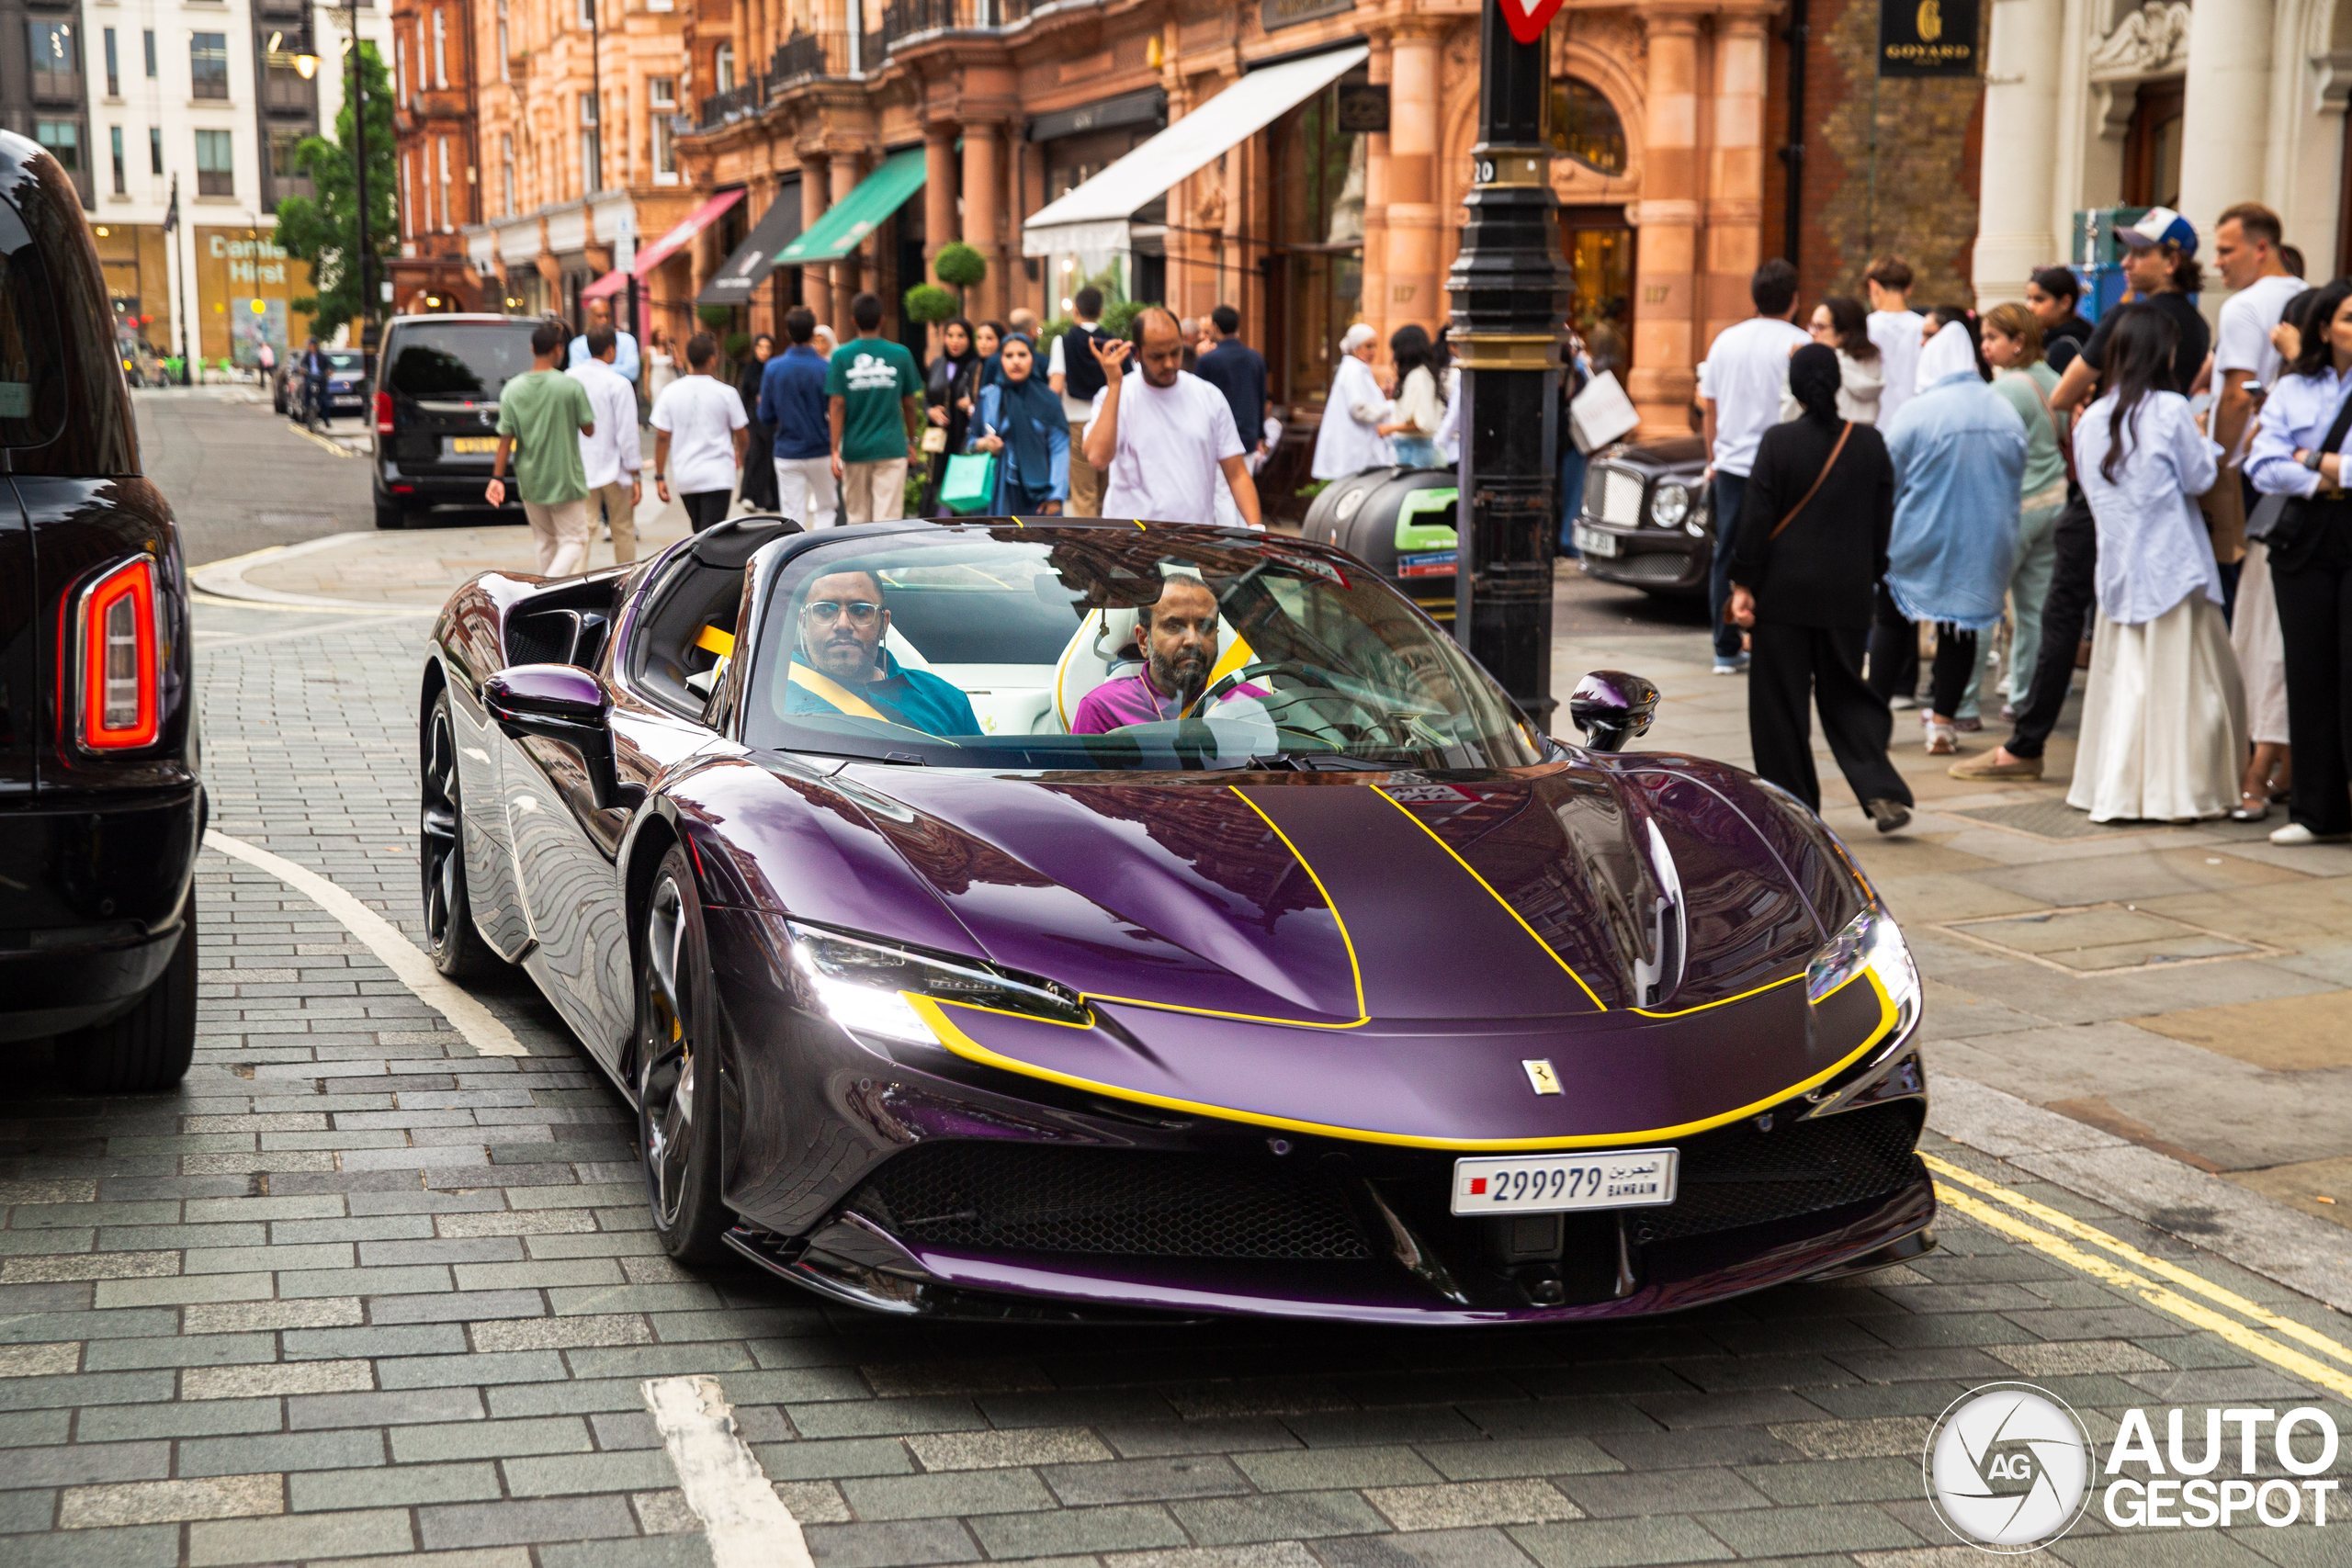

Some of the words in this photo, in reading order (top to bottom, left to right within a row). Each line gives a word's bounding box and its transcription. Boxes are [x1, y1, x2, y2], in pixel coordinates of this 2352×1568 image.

[1884, 43, 1971, 60] GOYARD
[209, 234, 288, 260] Damie
[230, 260, 286, 285] Hirst
[1610, 1161, 1659, 1179] البحرين
[1493, 1166, 1602, 1201] 299979
[1608, 1181, 1657, 1197] BAHRAIN
